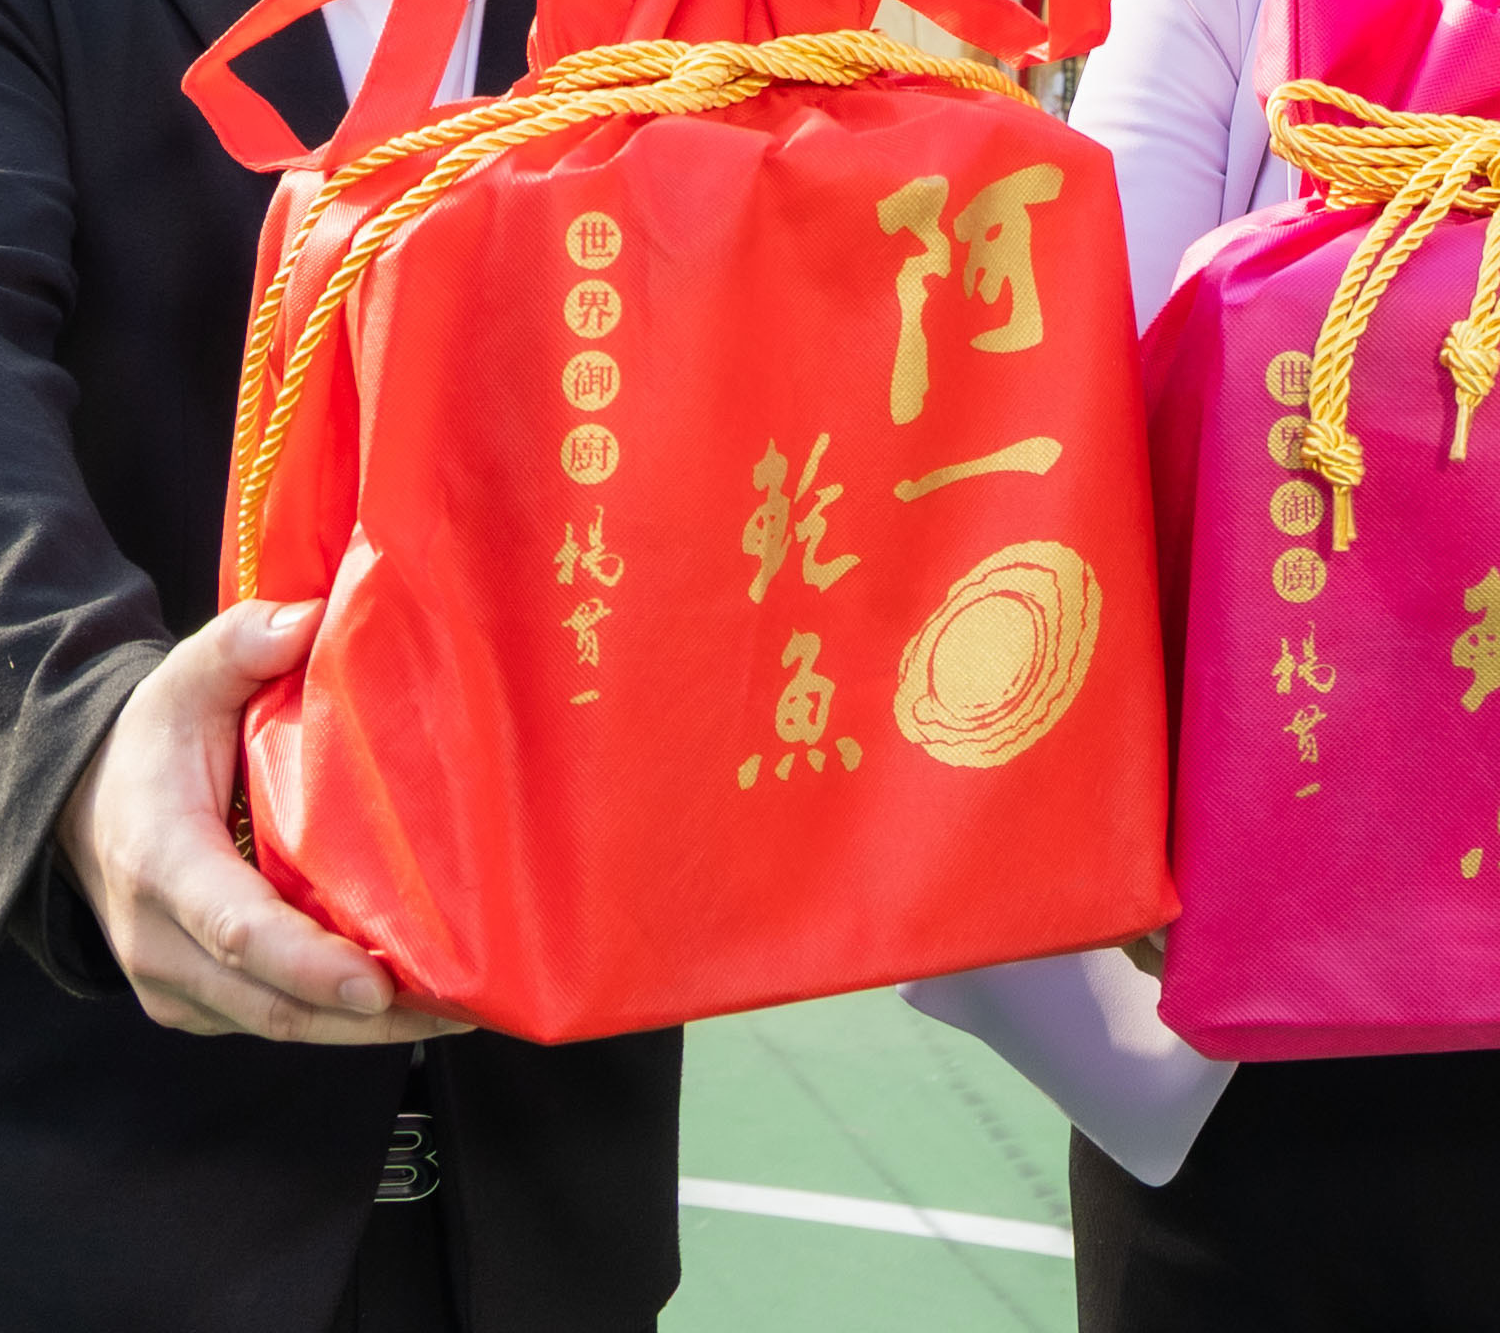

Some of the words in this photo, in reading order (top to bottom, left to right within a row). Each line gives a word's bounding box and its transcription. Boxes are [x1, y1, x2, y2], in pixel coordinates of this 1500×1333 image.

[564, 215, 619, 481] 世界御廚
[875, 162, 1065, 503] 阿一
[553, 505, 624, 706] 楊貫一
[1270, 621, 1337, 799] 楊貫一
